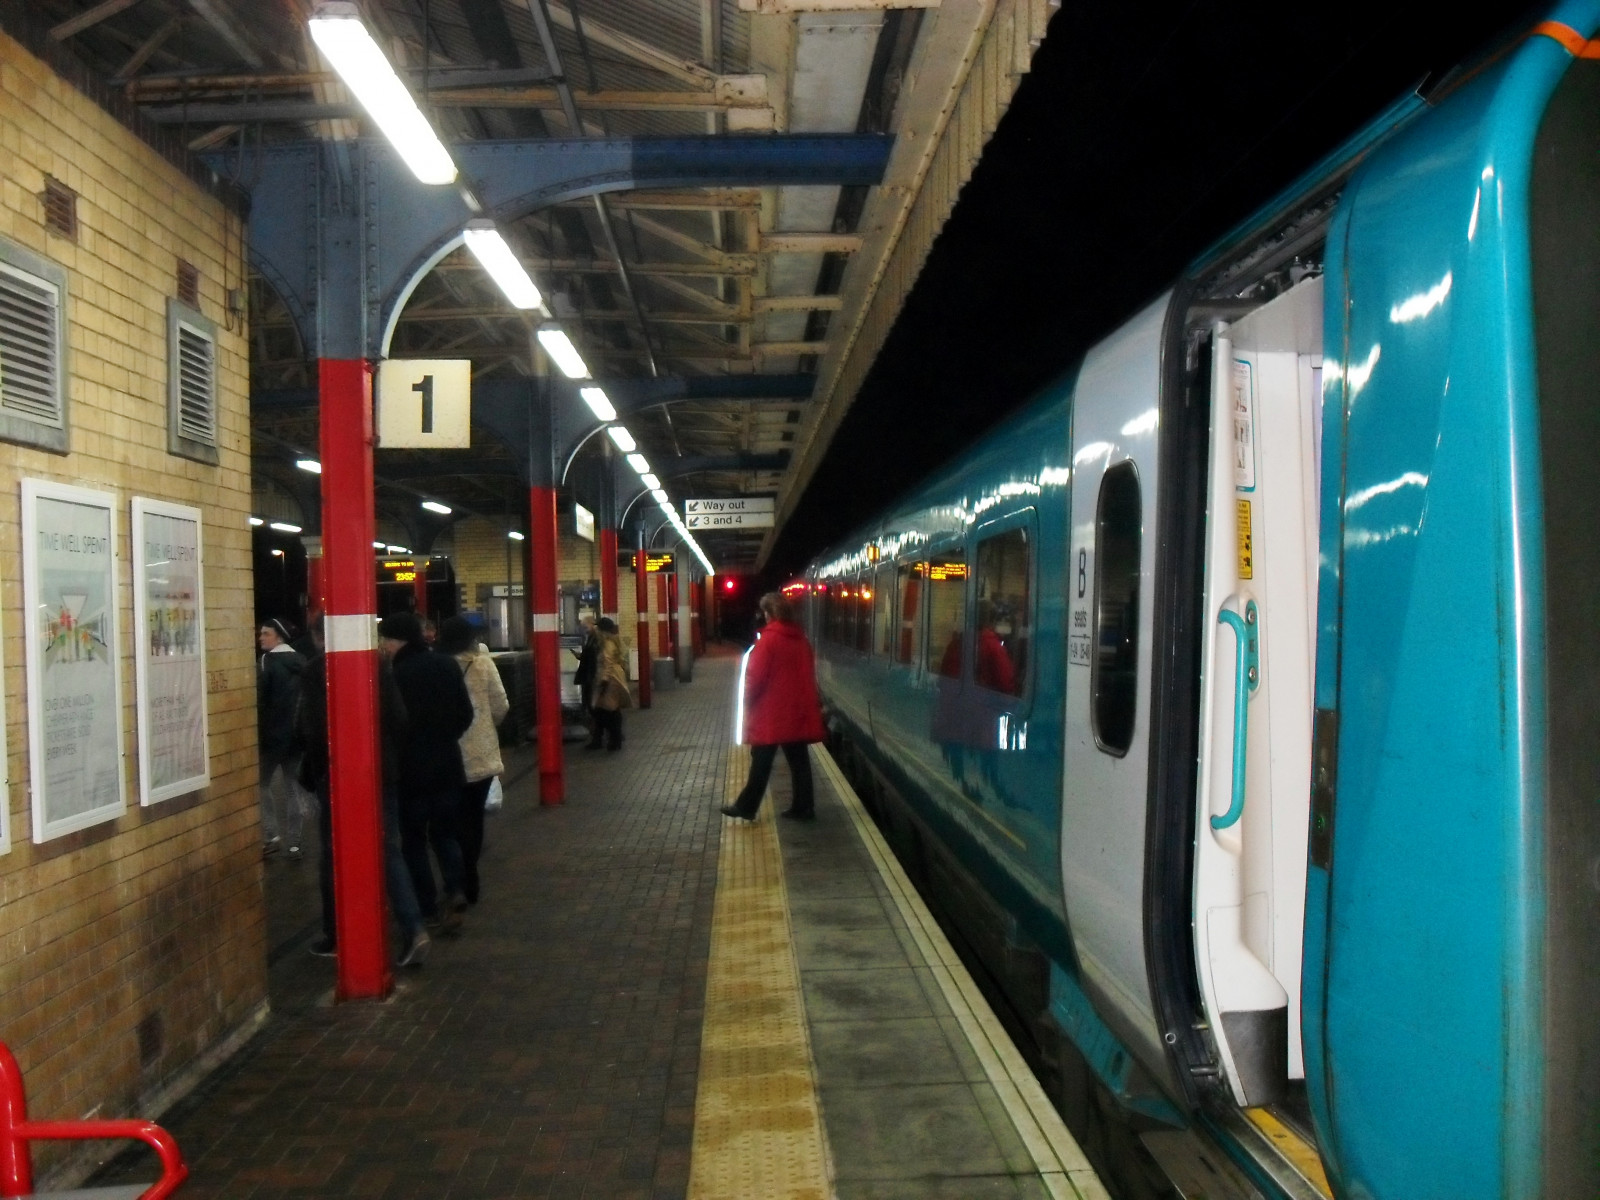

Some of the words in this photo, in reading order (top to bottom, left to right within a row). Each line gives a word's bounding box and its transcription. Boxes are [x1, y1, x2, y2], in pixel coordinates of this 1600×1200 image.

[411, 375, 433, 433] 1
[703, 501, 725, 511] Way
[728, 500, 745, 510] out
[703, 516, 710, 525] 3
[713, 516, 732, 525] and
[735, 515, 742, 524] 4
[39, 531, 58, 551] TIME
[61, 534, 80, 553] WELL
[83, 535, 107, 554] SPENT
[146, 541, 161, 559] TIME
[162, 544, 177, 561] WELL
[1078, 546, 1087, 598] B
